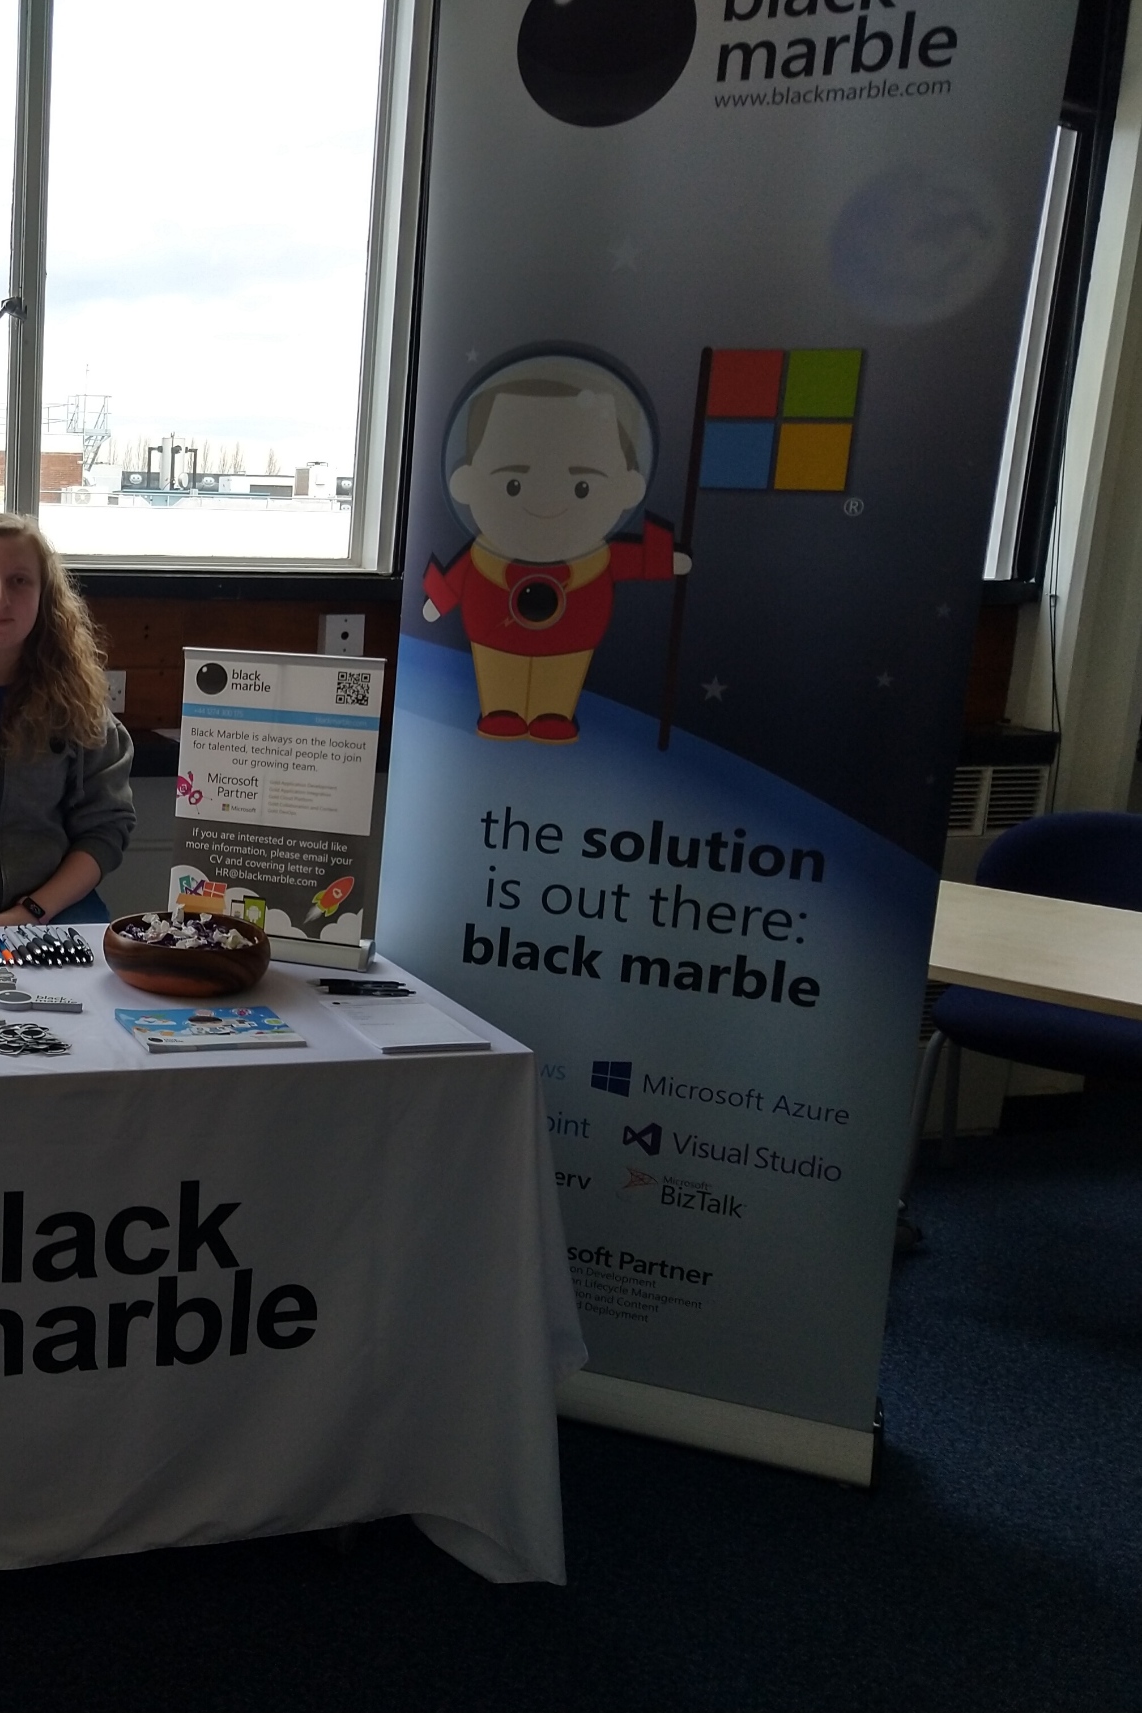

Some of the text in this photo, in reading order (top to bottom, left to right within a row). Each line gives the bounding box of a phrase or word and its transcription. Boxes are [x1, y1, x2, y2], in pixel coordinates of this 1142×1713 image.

[716, 10, 958, 82] marble
[714, 79, 952, 109] www.blackmarble.com
[232, 669, 260, 681] black
[231, 681, 271, 693] marble
[191, 728, 366, 750] Black Marble is always on the lookout
[193, 741, 361, 763] for talented, technical people to join
[232, 758, 318, 772] our growing team.
[207, 773, 259, 787] Microsoft
[217, 787, 259, 800] Partner
[231, 805, 256, 813] Microsoft
[192, 828, 199, 837] If
[200, 830, 218, 840] you
[237, 832, 284, 846] interested
[287, 839, 296, 847] or
[298, 840, 328, 851] would
[331, 842, 347, 853] like
[480, 806, 825, 883] the solution
[185, 841, 353, 866] more information, please email your
[209, 854, 326, 876] CV and covering letter to
[215, 867, 317, 887] HR@blackmarble.com
[486, 865, 808, 945] is out there:
[462, 922, 820, 1008] black marble
[643, 1073, 850, 1125] Microsoft Azure
[672, 1132, 842, 1182] Visual Studio
[663, 1176, 709, 1191] Microsoft
[660, 1185, 742, 1218] BizTalk
[586, 1267, 656, 1288] Development
[619, 1251, 713, 1286] Partner
[585, 1278, 629, 1295] Lifecycle
[631, 1288, 703, 1309] Management
[594, 1294, 614, 1304] and
[616, 1296, 659, 1313] Content
[584, 1303, 649, 1323] Deployment
